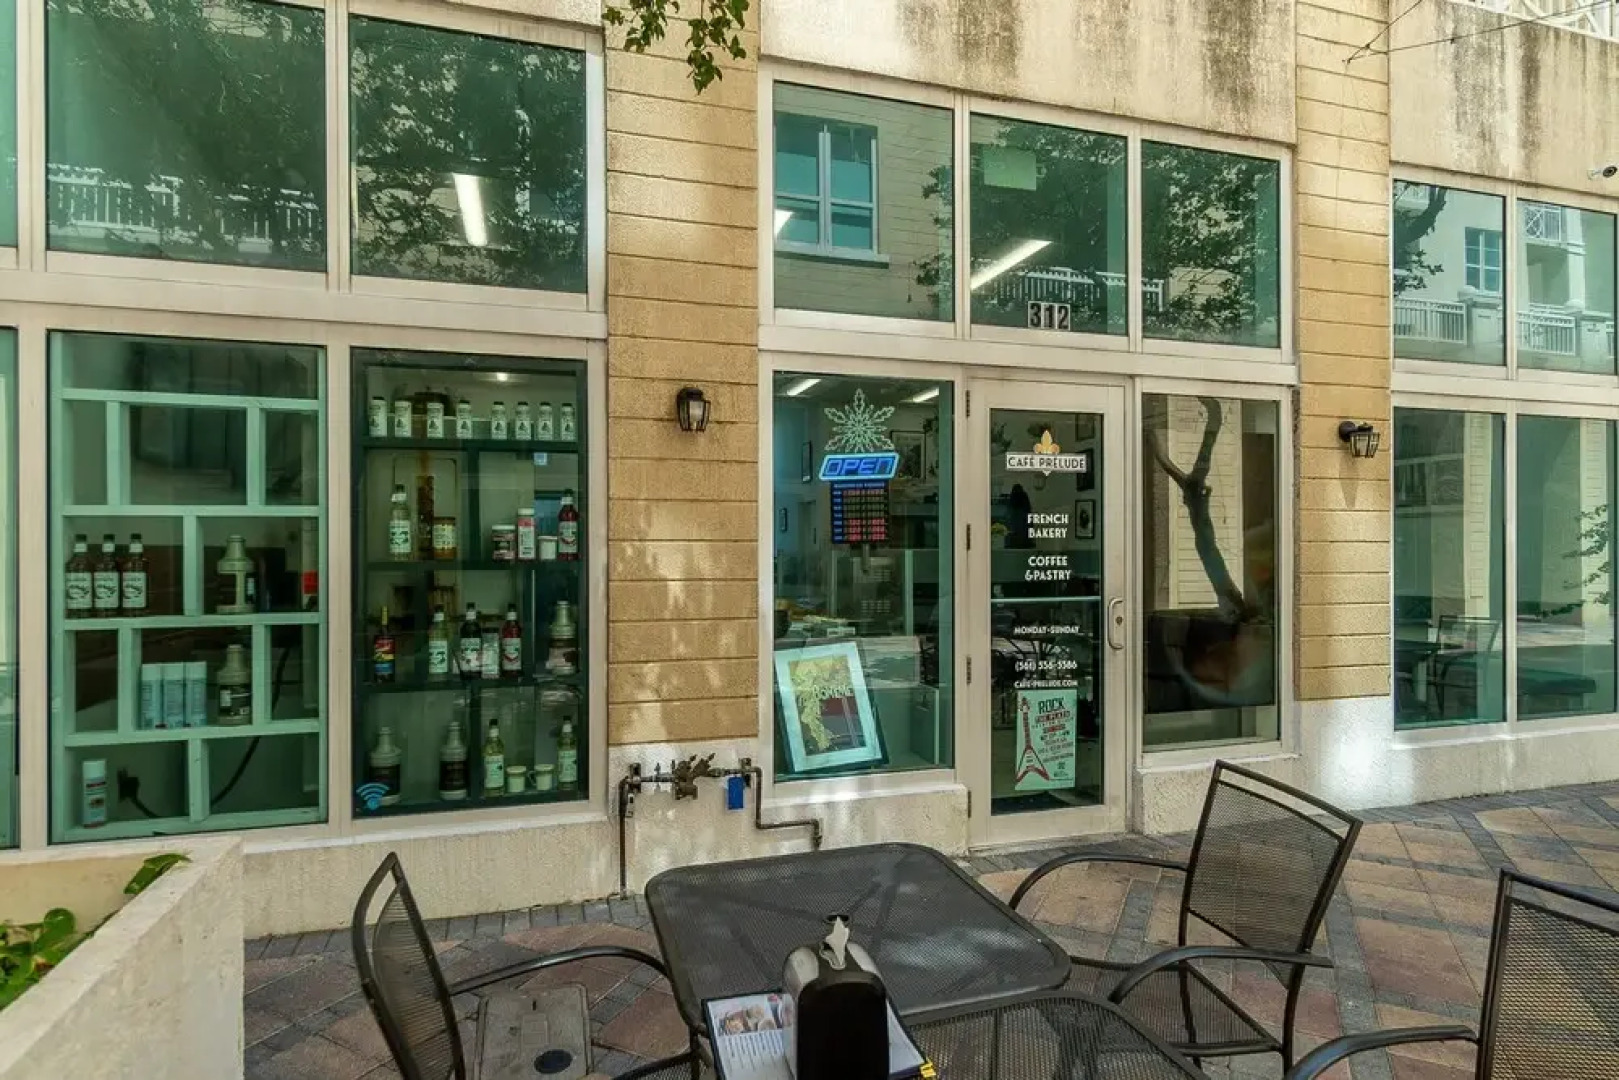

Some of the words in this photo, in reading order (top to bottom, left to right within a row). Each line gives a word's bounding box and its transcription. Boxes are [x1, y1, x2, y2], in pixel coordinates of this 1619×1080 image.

[1029, 302, 1070, 329] 312
[825, 457, 893, 476] OPEN
[1027, 514, 1069, 524] FRENCH
[1027, 527, 1067, 538] BAKERY
[1028, 556, 1067, 566] COFFEE
[1025, 569, 1071, 581] &PASTRY
[1038, 697, 1065, 714] ROCK
